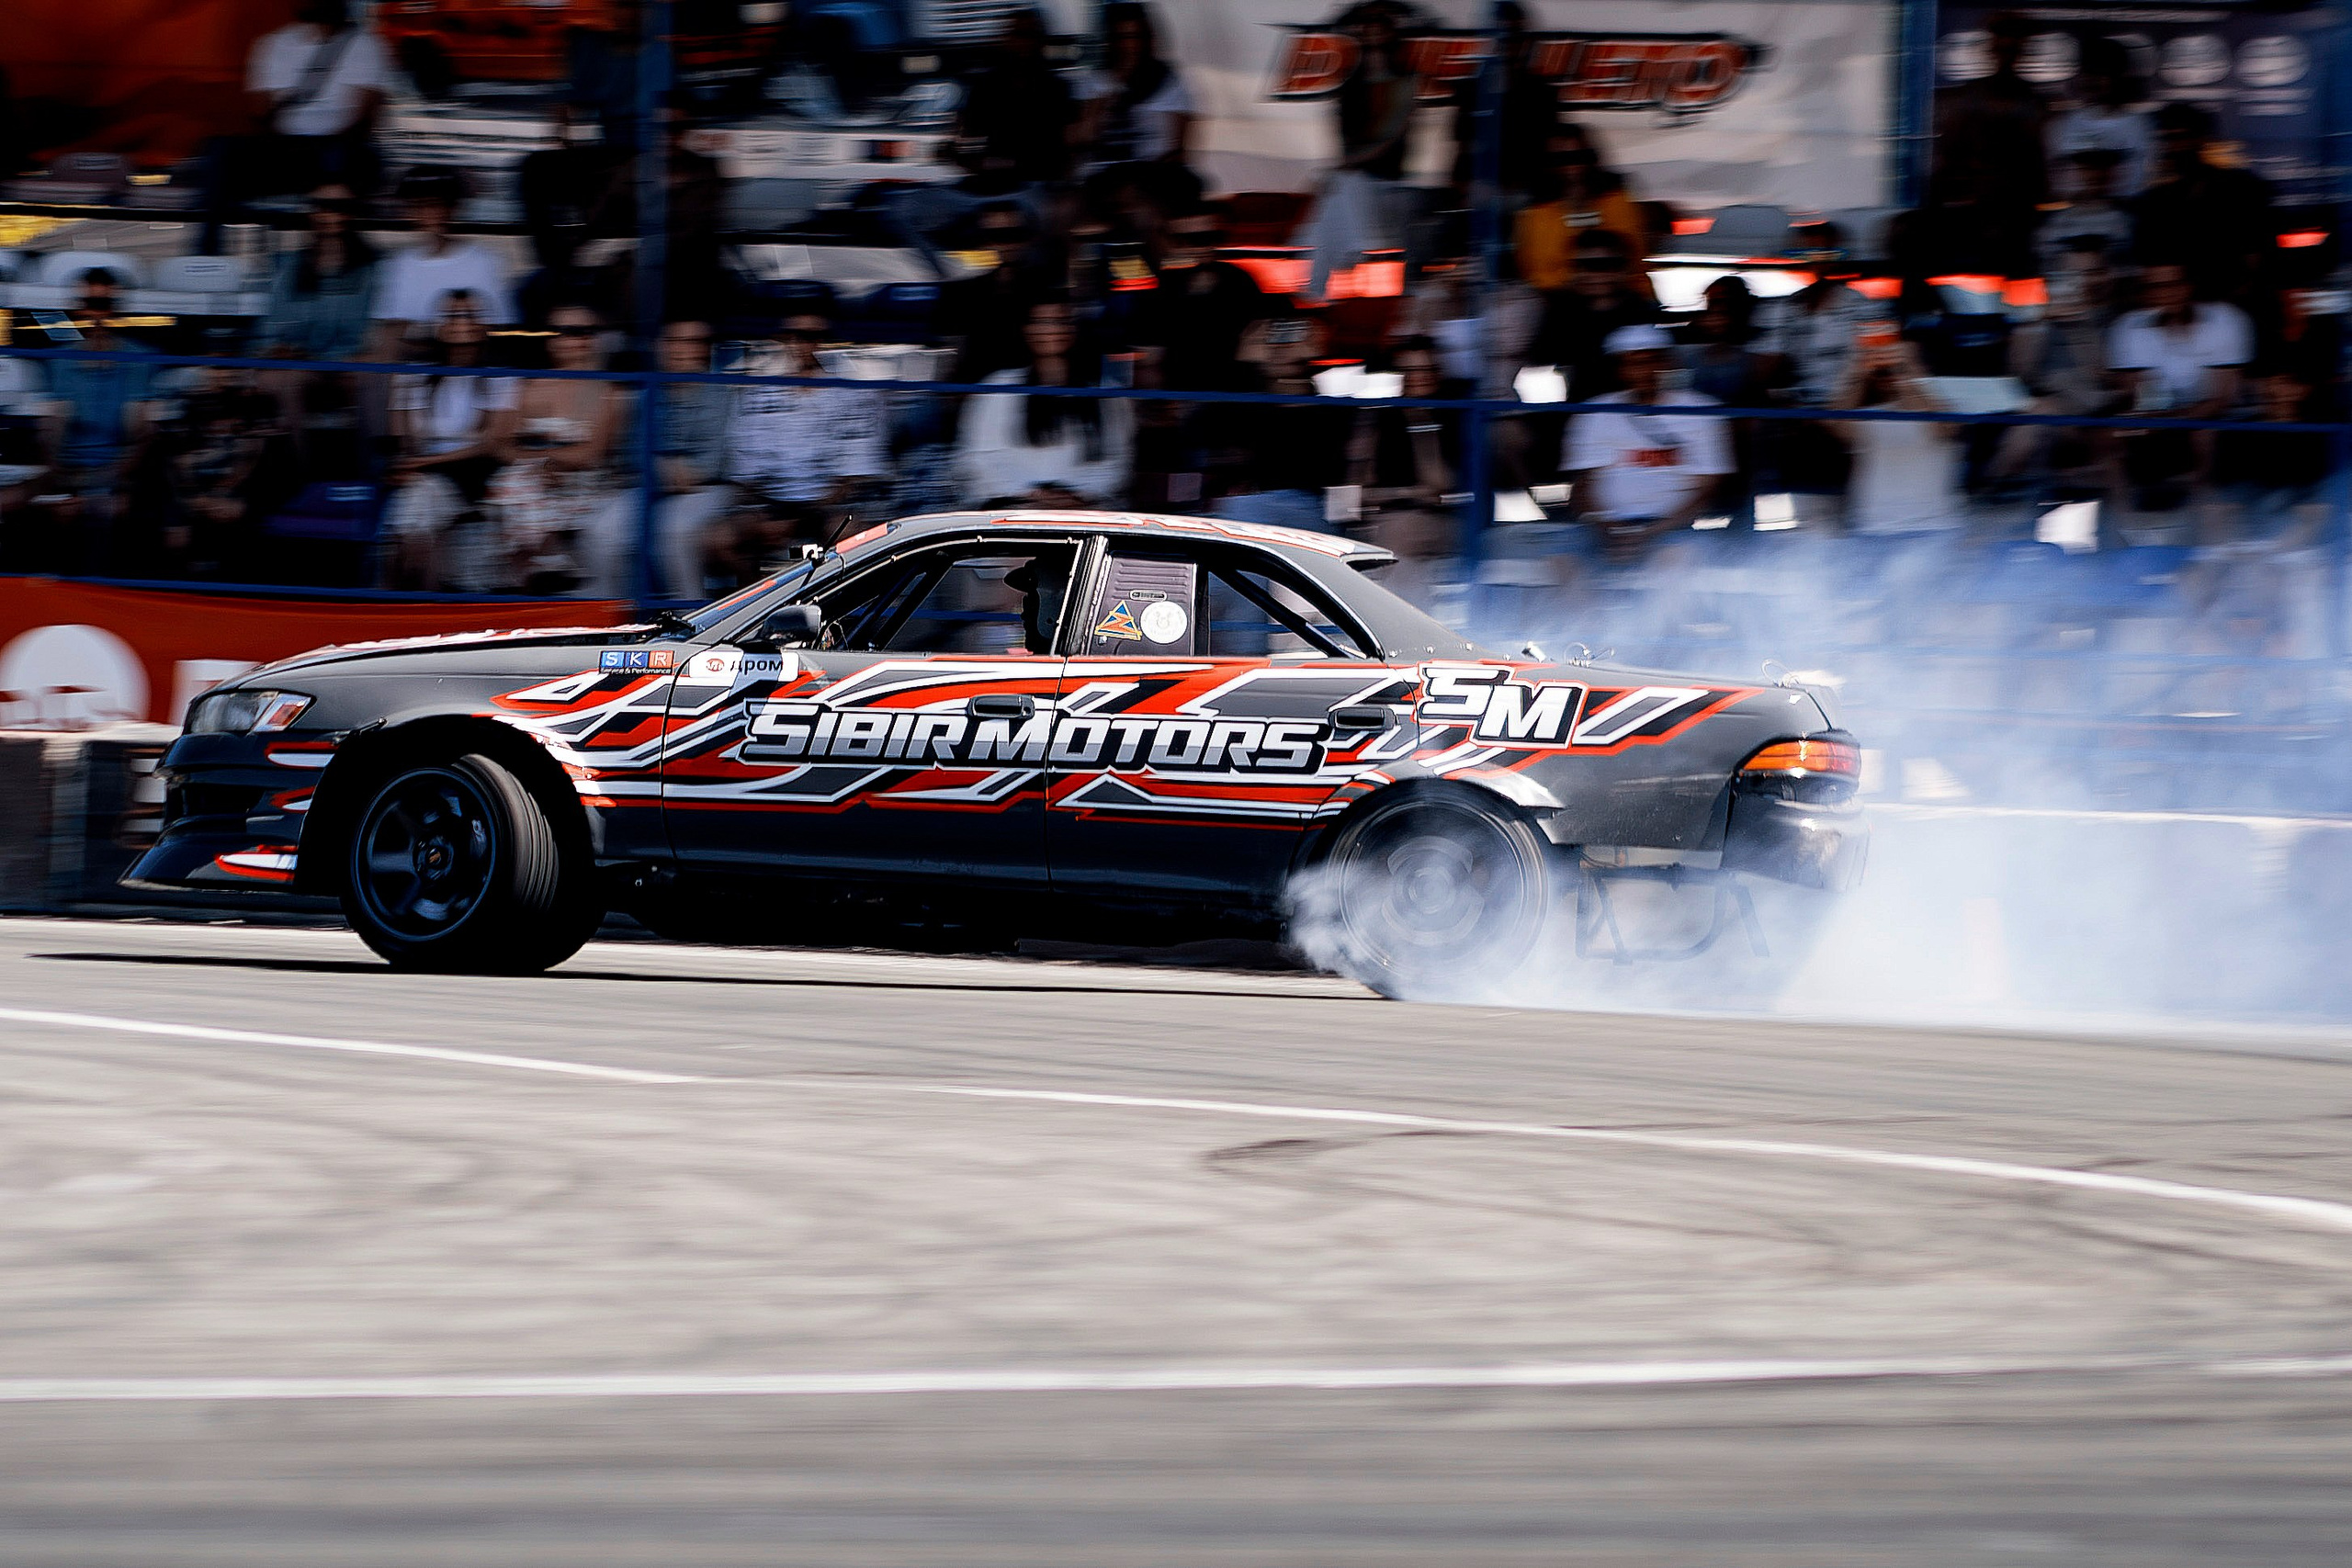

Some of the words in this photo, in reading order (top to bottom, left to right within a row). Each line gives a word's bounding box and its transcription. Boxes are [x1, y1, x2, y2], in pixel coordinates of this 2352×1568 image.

[605, 651, 667, 666] SKR
[1421, 667, 1576, 739] SM
[745, 704, 967, 761] SIBIR
[969, 711, 1325, 767] MOTORS
